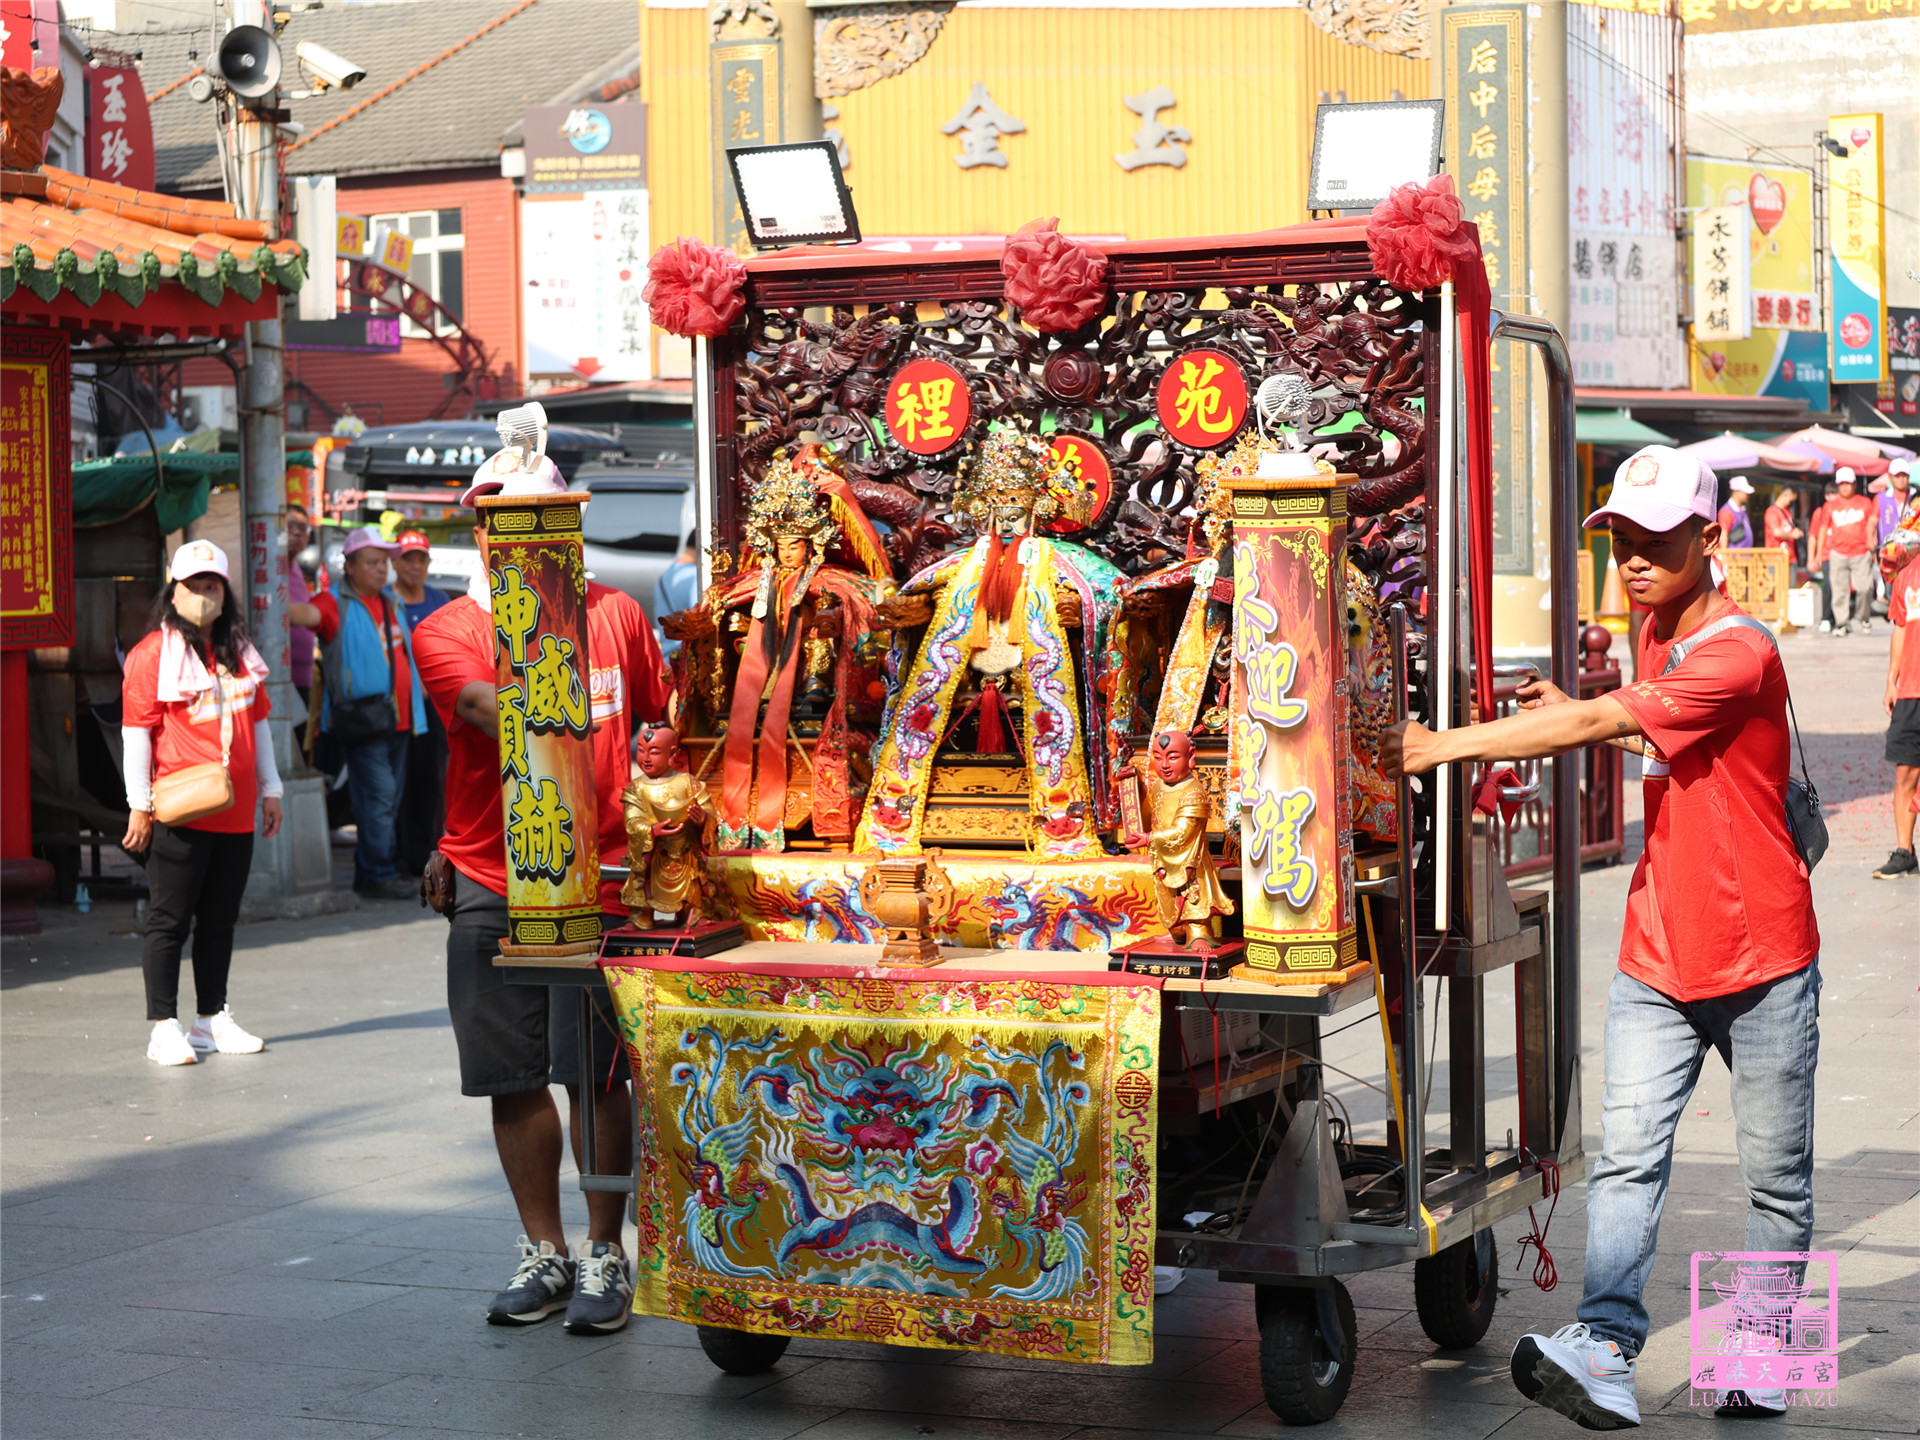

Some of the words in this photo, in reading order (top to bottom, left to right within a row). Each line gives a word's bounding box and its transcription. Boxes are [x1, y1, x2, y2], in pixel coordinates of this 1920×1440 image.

[100, 73, 134, 184] 玉珍
[1327, 179, 1347, 190] mini
[1705, 215, 1733, 332] 永芳餅舖
[894, 377, 956, 444] 裡
[1175, 358, 1234, 434] 苑
